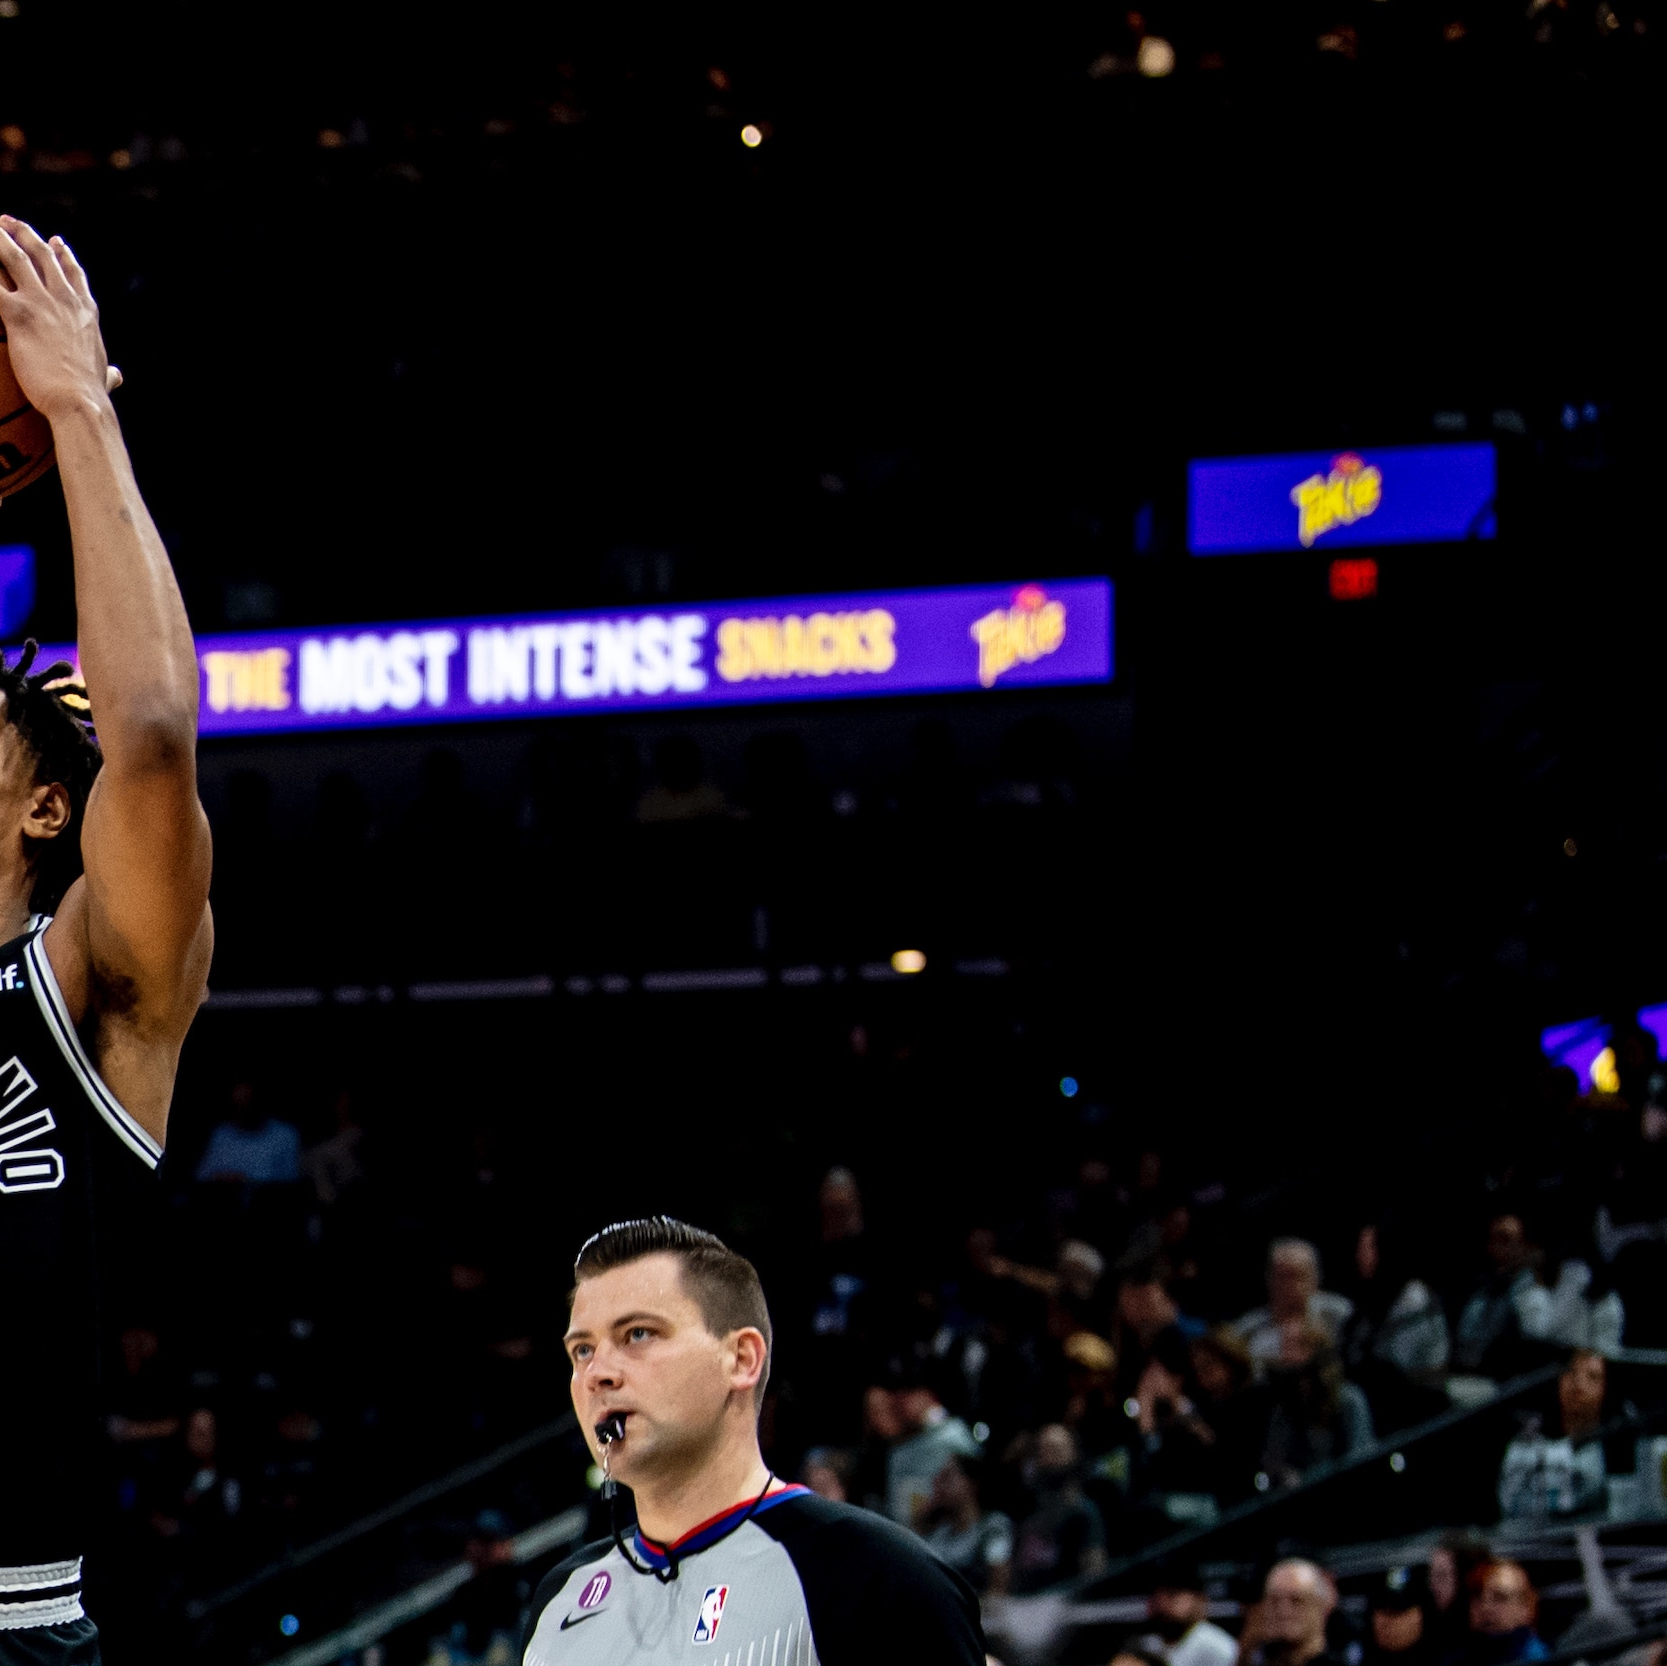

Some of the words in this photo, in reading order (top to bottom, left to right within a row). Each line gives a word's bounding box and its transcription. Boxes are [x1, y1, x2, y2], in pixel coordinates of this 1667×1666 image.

[201, 647, 291, 714] THE
[299, 629, 459, 716] MOST
[467, 613, 709, 705] INTENSE
[715, 608, 897, 683] SNACKS
